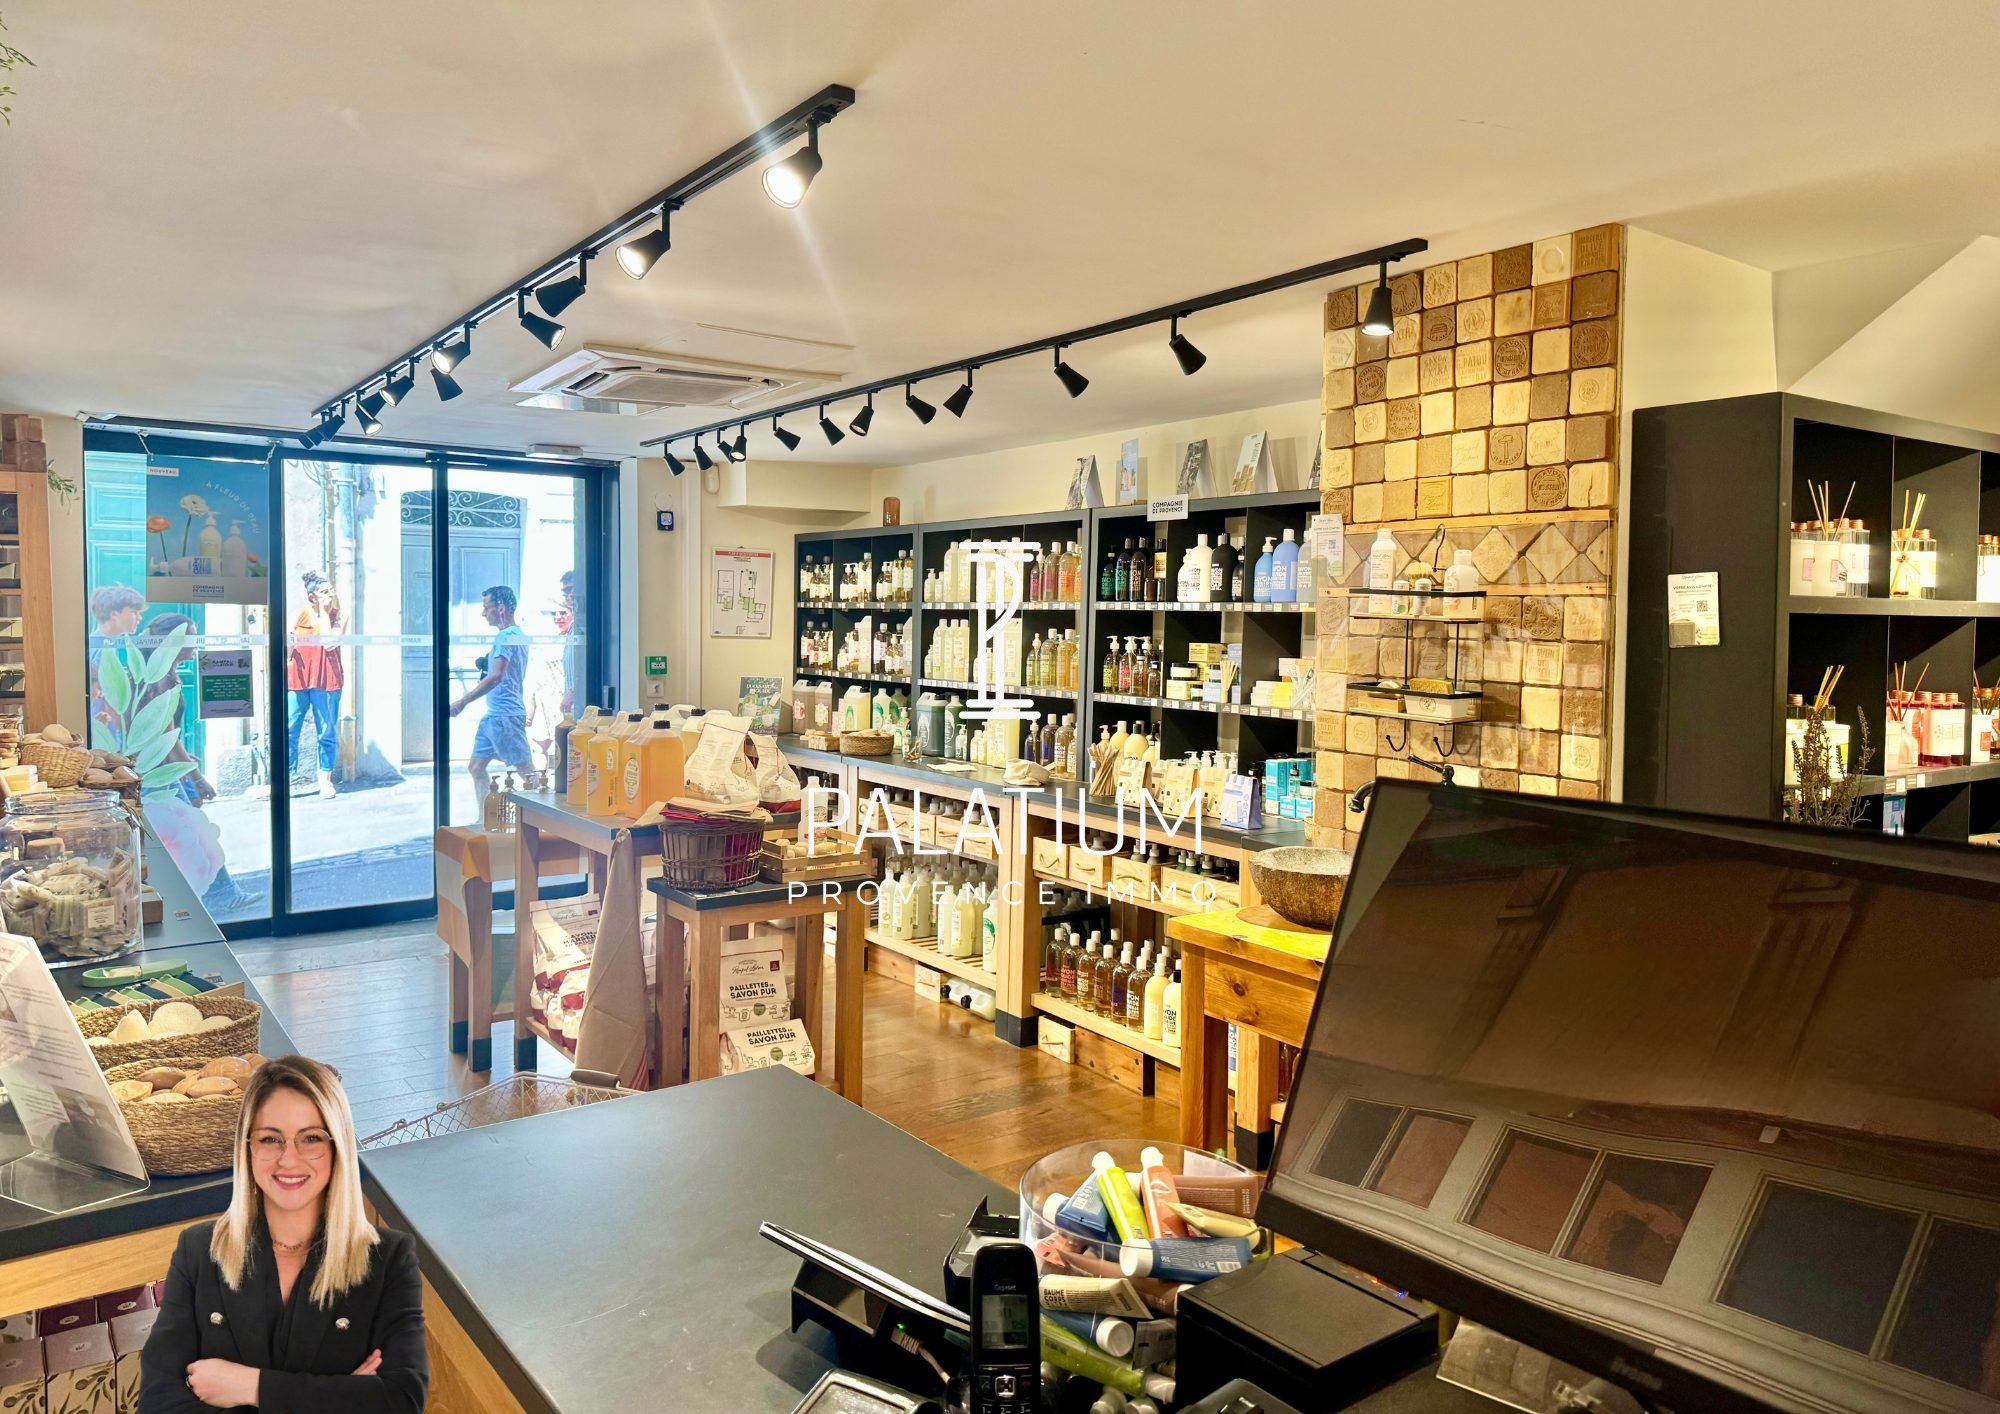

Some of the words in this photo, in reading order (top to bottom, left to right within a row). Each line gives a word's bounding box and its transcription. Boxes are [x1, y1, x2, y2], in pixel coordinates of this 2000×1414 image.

[1152, 500, 1184, 509] COMPAGNIE
[729, 981, 769, 992] PAILLETTES
[730, 989, 759, 999] SAVON
[760, 987, 777, 995] PUR
[747, 1027, 787, 1038] PAILLETTES
[748, 1034, 777, 1045] SAVON
[779, 1031, 797, 1040] PUR
[1043, 1288, 1064, 1296] BAUME
